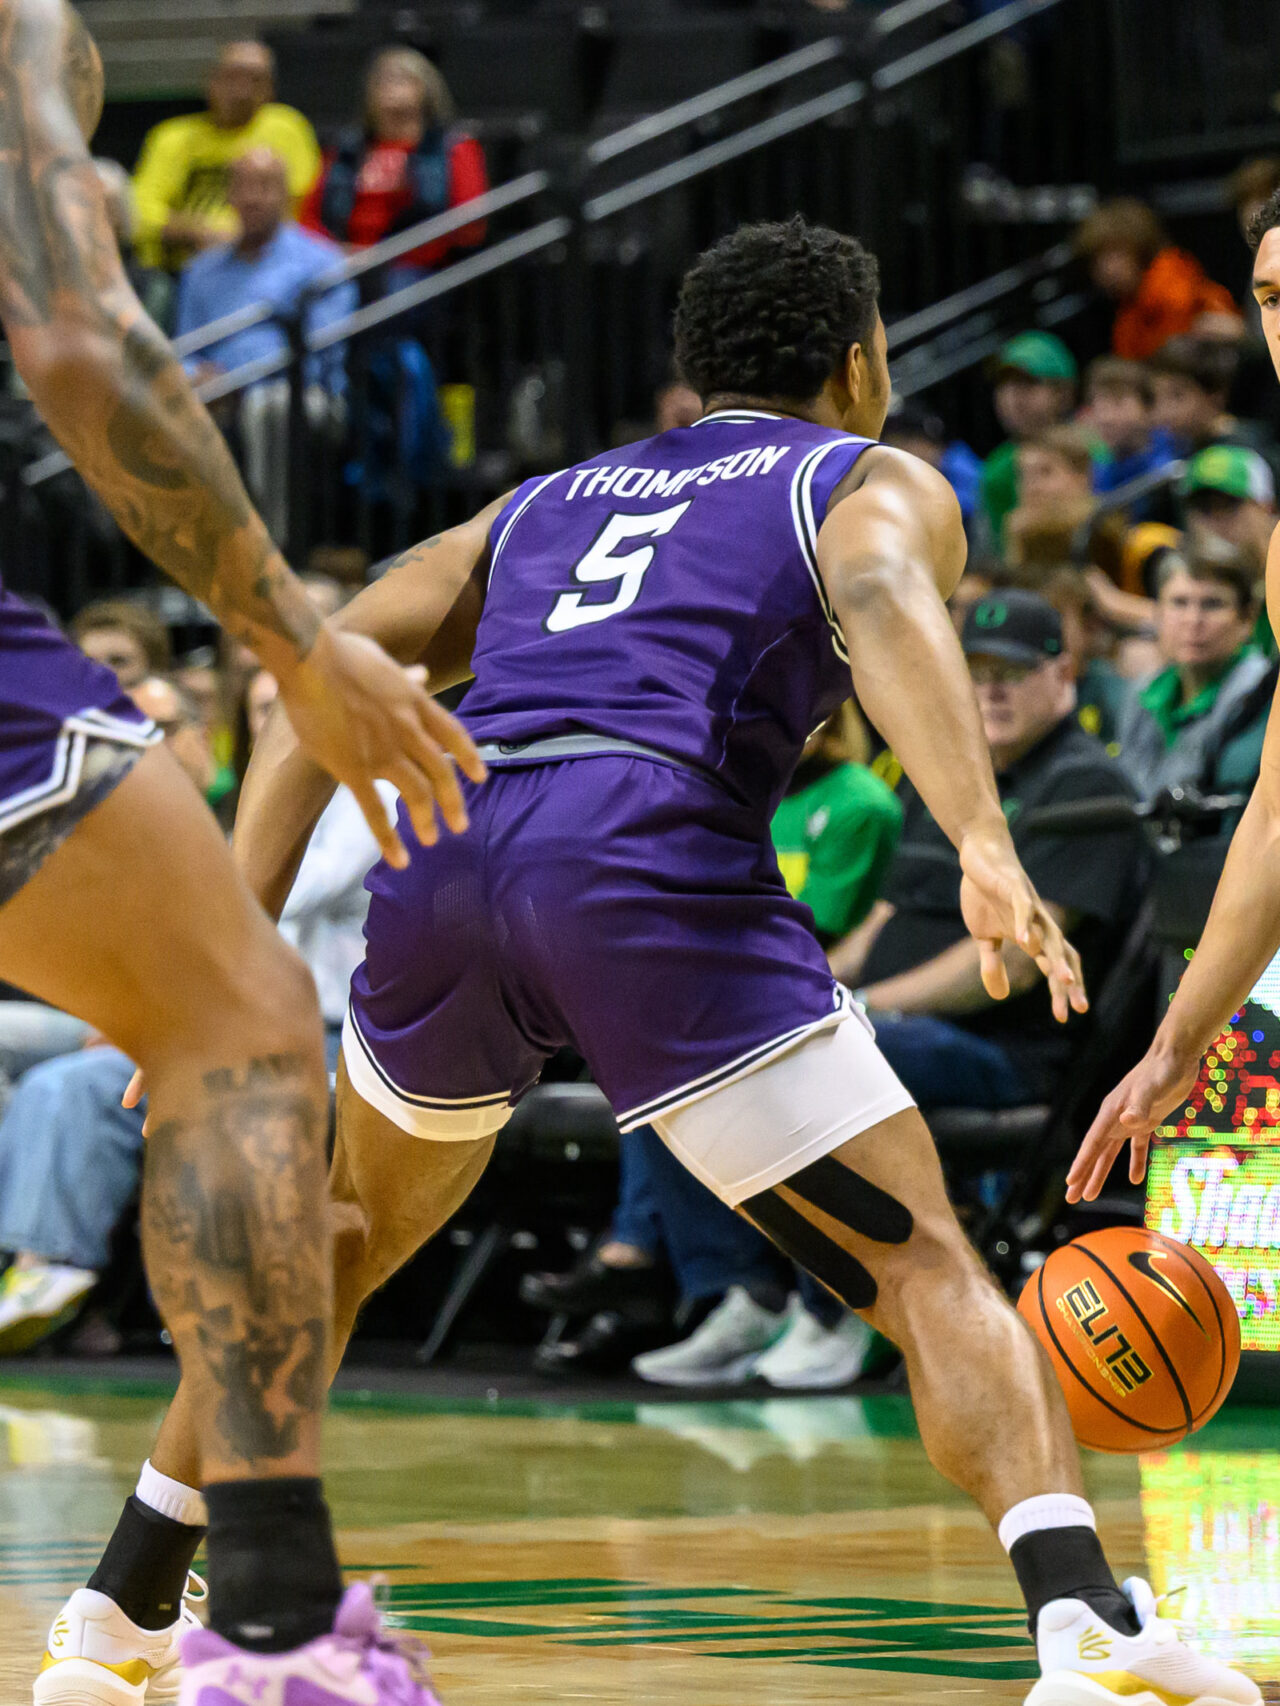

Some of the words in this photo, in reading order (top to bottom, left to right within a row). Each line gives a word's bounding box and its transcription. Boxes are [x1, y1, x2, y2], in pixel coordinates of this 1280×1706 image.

[565, 445, 791, 501] THOMPSON
[542, 497, 696, 634] 5
[1062, 1276, 1155, 1393] ELITE
